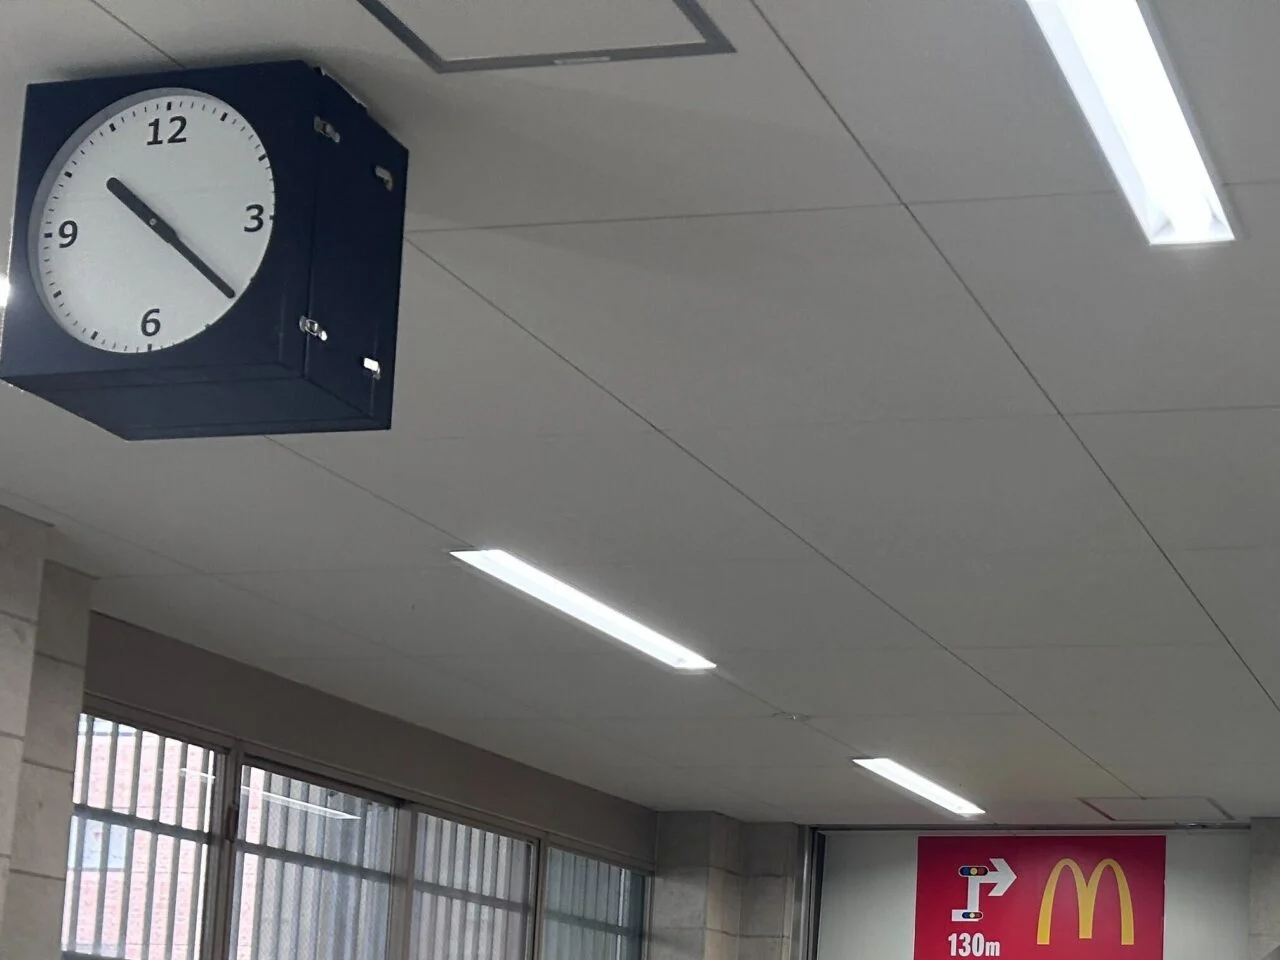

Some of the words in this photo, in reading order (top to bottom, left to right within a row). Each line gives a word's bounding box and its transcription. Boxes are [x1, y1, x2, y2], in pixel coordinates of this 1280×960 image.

[147, 115, 187, 146] 12
[243, 204, 264, 232] 3
[58, 220, 78, 248] 9
[140, 308, 161, 336] 6
[948, 932, 1000, 958] 130m
